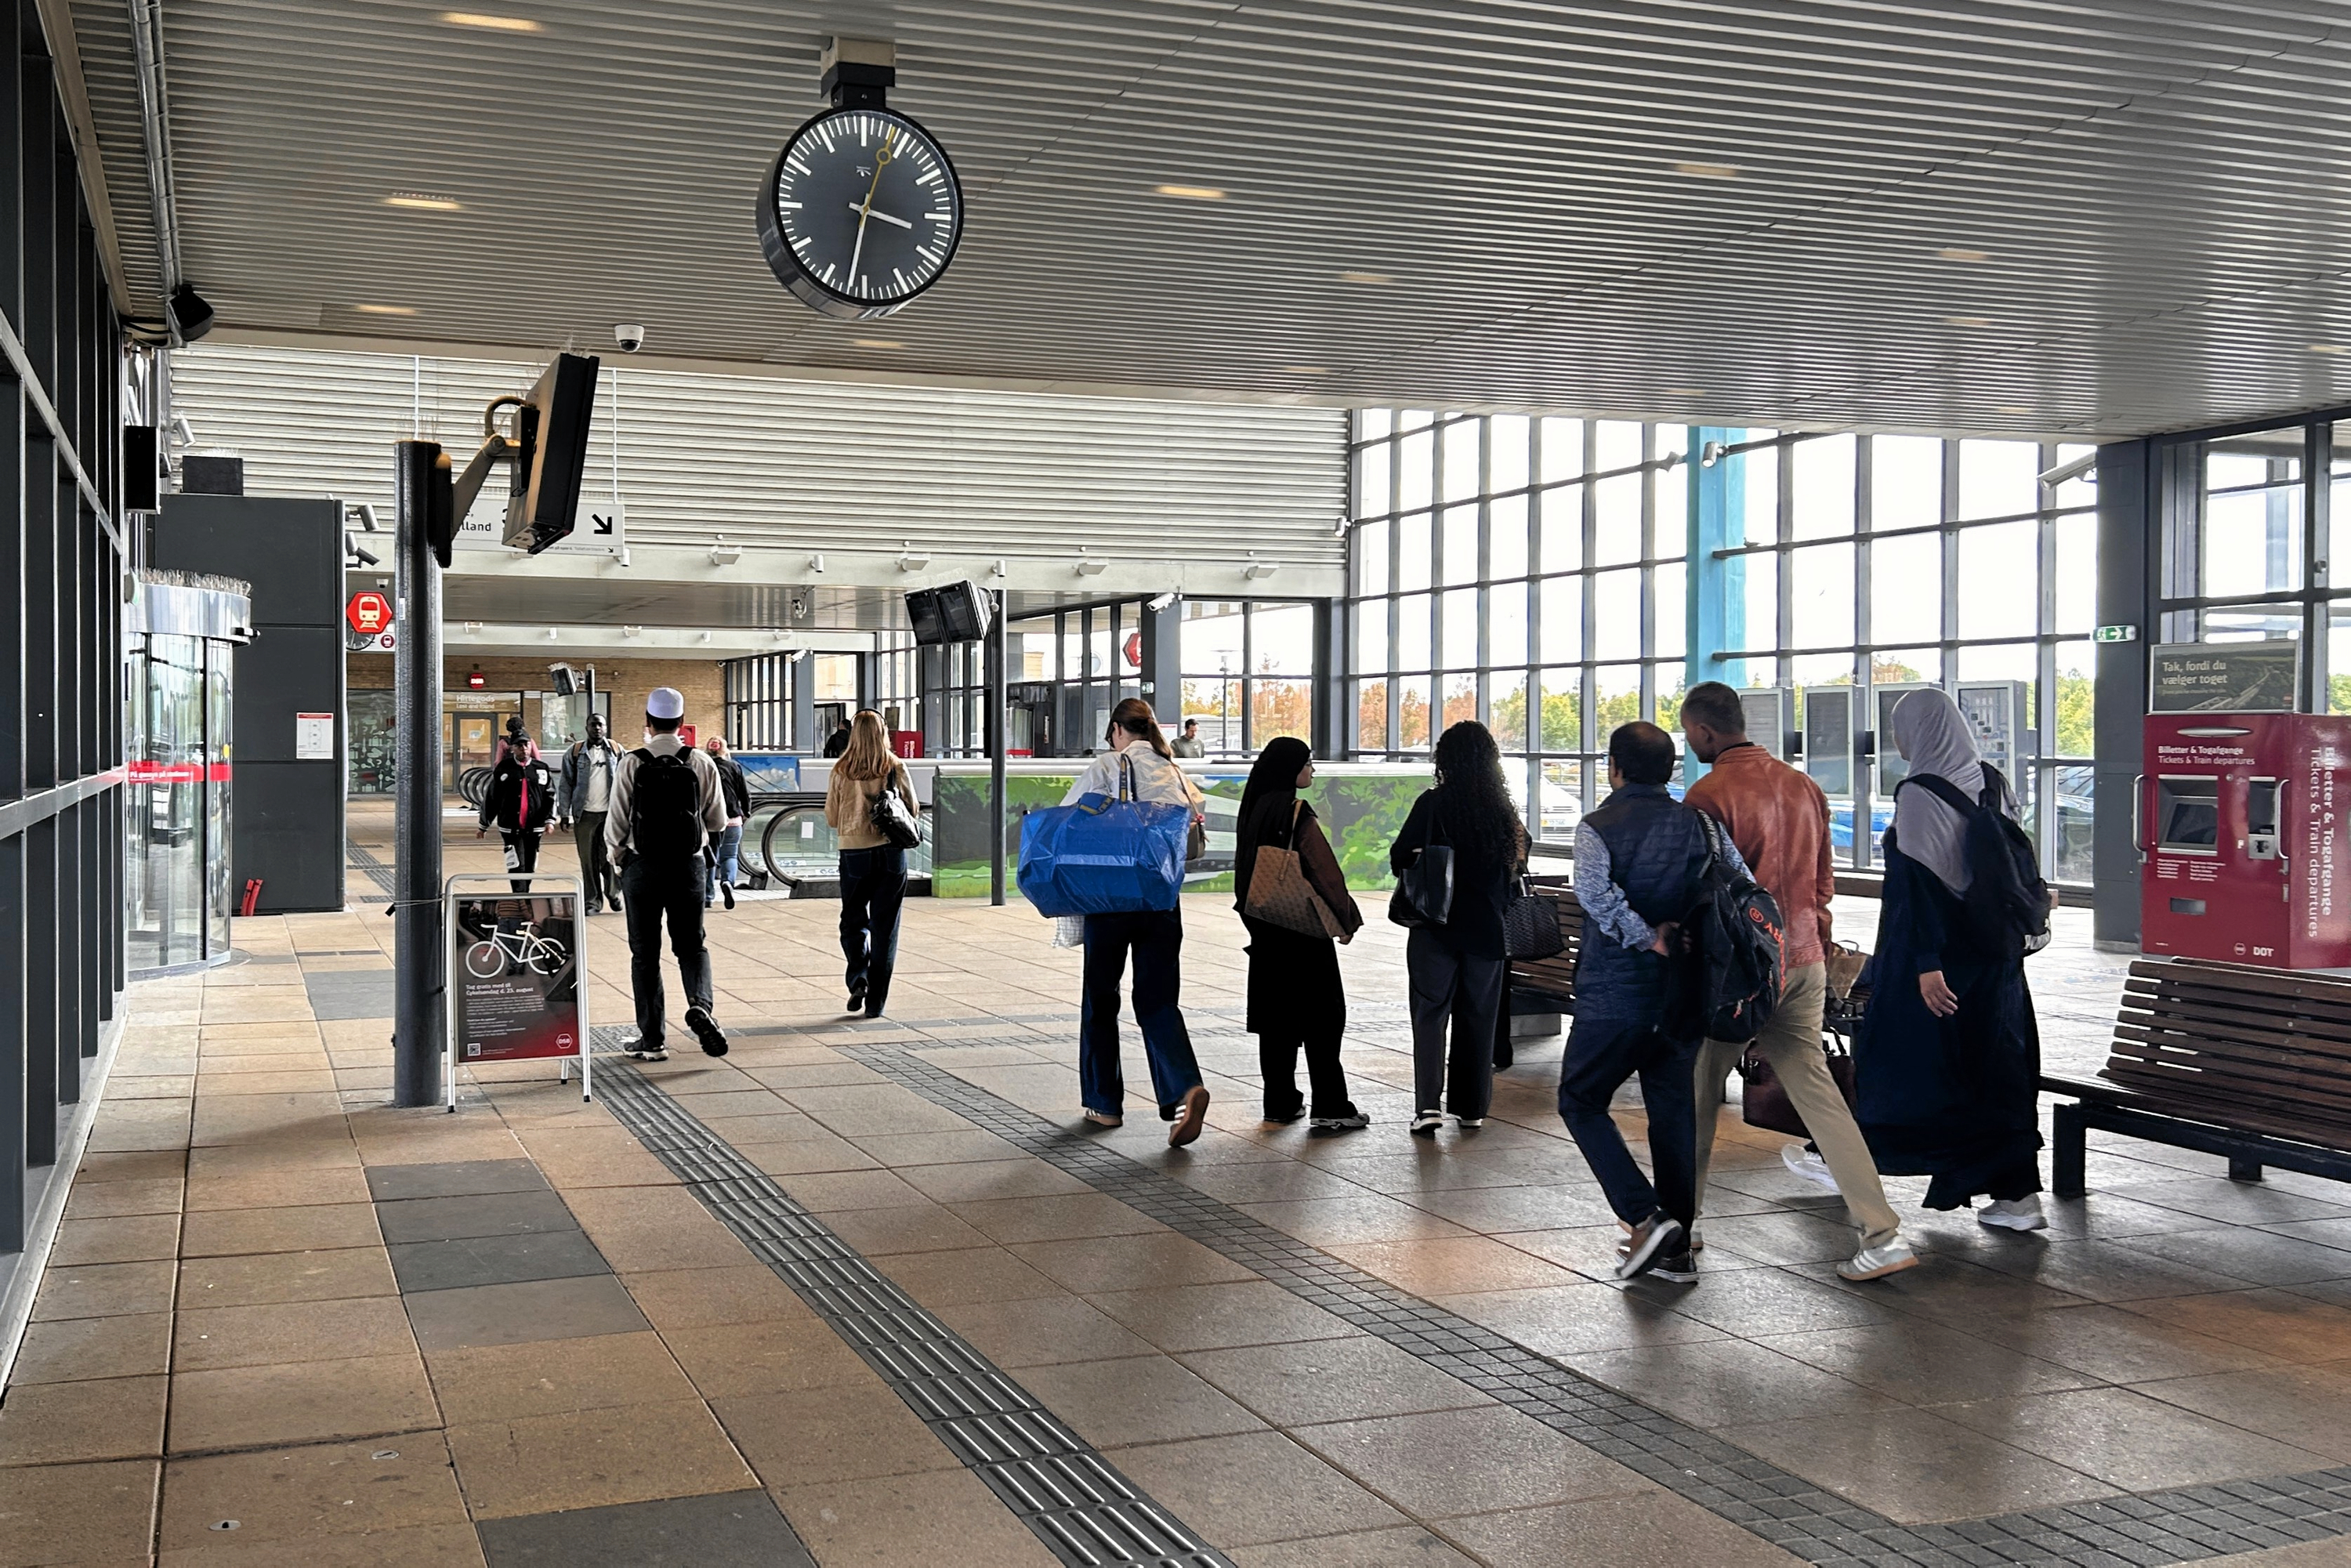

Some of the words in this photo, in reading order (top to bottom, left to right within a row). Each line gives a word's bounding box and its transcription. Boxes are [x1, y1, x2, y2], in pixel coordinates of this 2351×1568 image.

[2162, 661, 2183, 672] Tak,
[2186, 661, 2210, 671] fordi
[2212, 661, 2226, 670] du
[2162, 675, 2197, 686] vælger
[2200, 674, 2228, 685] toget
[2158, 755, 2184, 764] Tickets
[2186, 755, 2191, 764] &
[2213, 757, 2255, 766] departures
[2310, 747, 2321, 798] Tickets
[2324, 747, 2335, 808] Billetter
[2310, 803, 2321, 813] &
[2323, 812, 2335, 824] &
[2309, 819, 2321, 853] Train
[2320, 827, 2335, 915] Togafgange
[2307, 859, 2320, 938] departures
[2253, 946, 2274, 957] DOT
